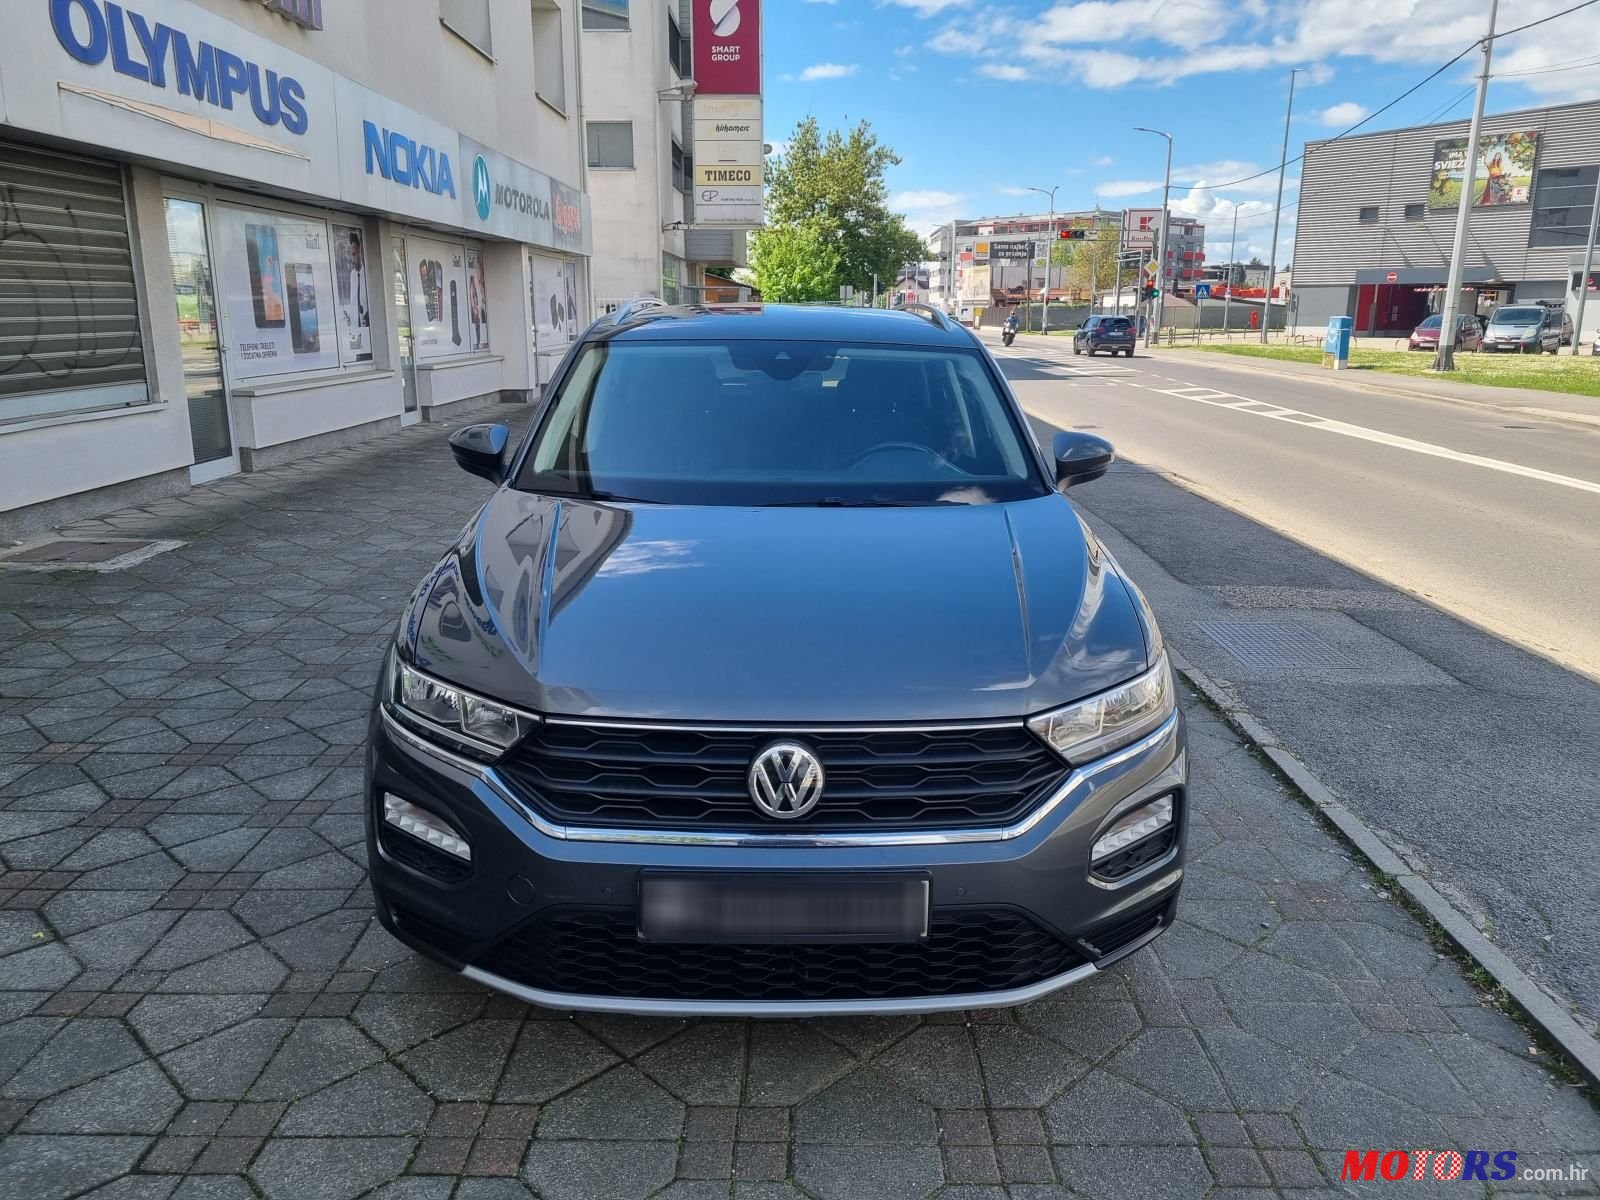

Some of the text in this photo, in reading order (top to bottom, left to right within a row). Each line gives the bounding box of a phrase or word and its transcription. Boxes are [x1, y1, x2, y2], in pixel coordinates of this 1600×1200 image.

[49, 0, 309, 135] OLYMPUS
[363, 120, 456, 200] NOKIA
[705, 170, 751, 181] TIMECO
[495, 183, 550, 222] MOTOROLA
